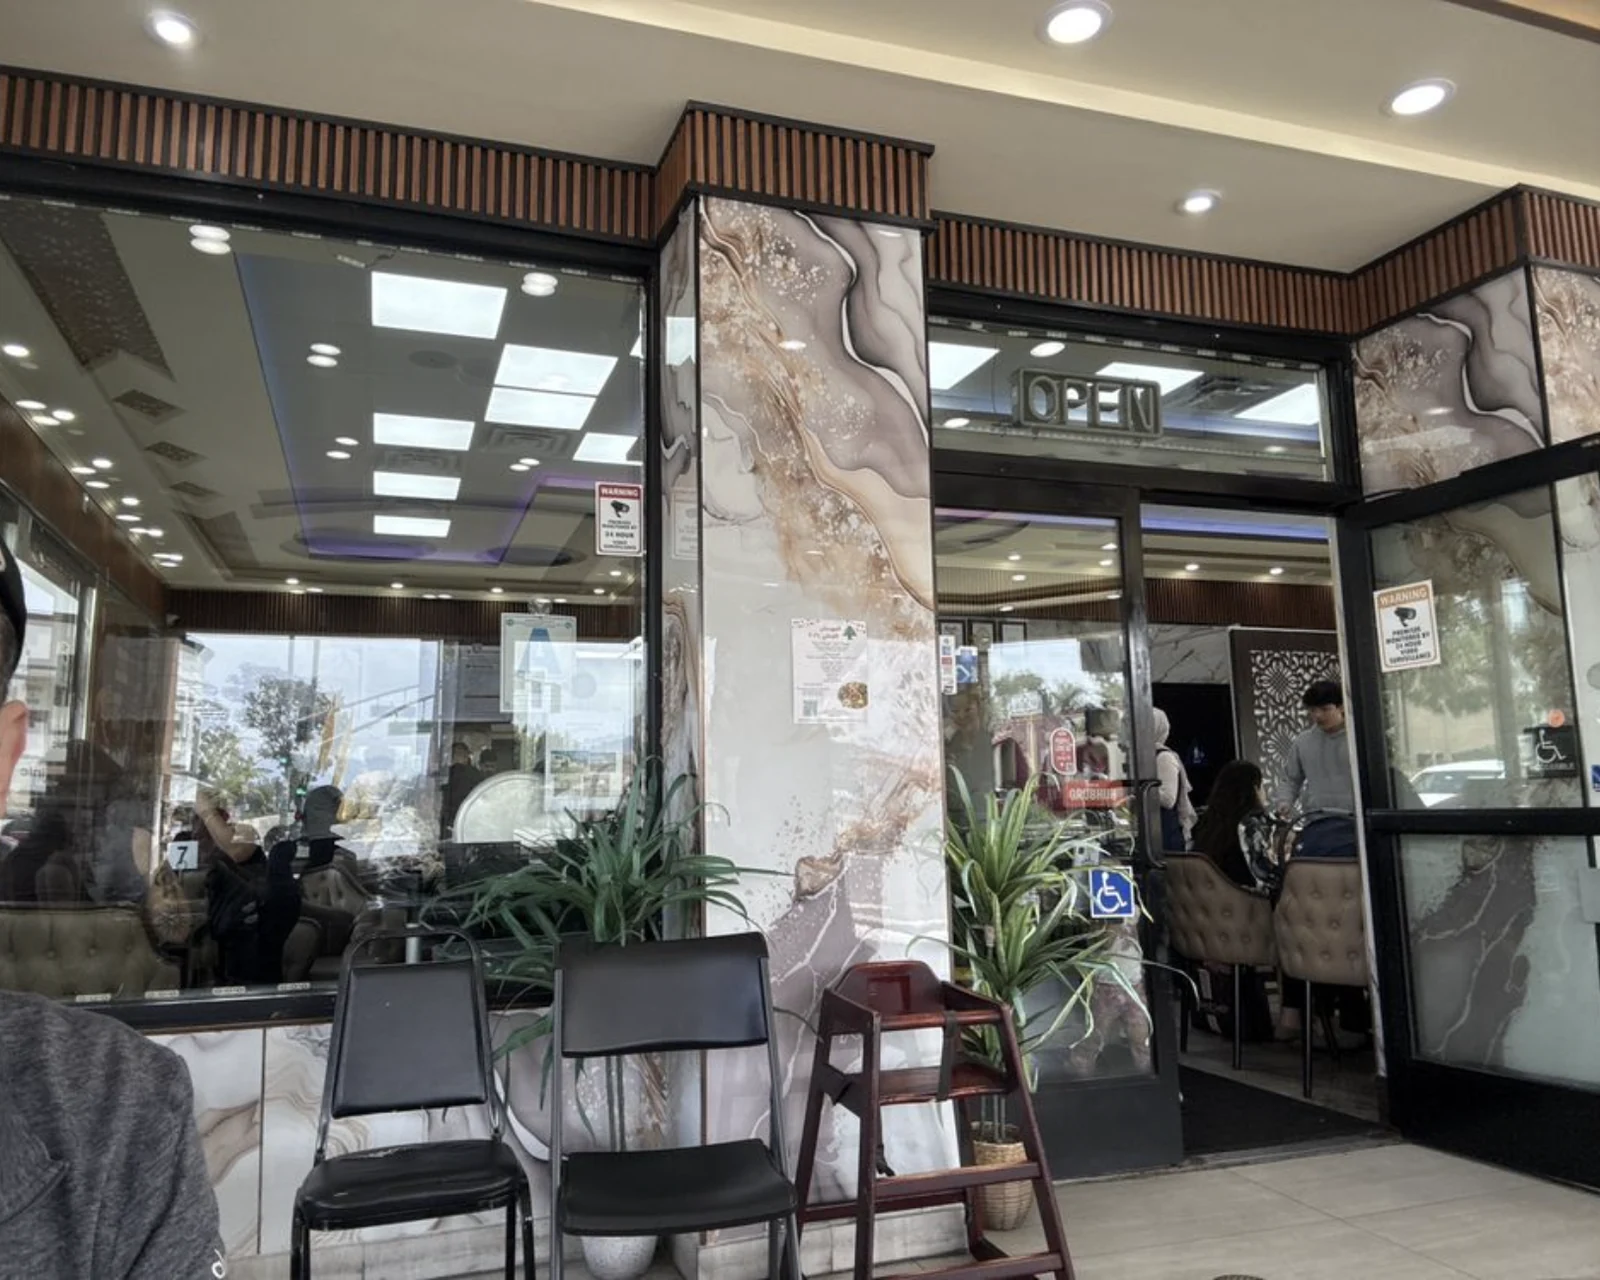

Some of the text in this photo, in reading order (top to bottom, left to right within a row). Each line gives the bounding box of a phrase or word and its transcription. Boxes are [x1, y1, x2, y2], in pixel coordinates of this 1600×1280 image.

[1028, 376, 1155, 433] OPEN
[601, 488, 638, 497] WARNING
[1380, 588, 1427, 604] WARNING
[518, 628, 563, 675] A
[177, 845, 188, 865] 7
